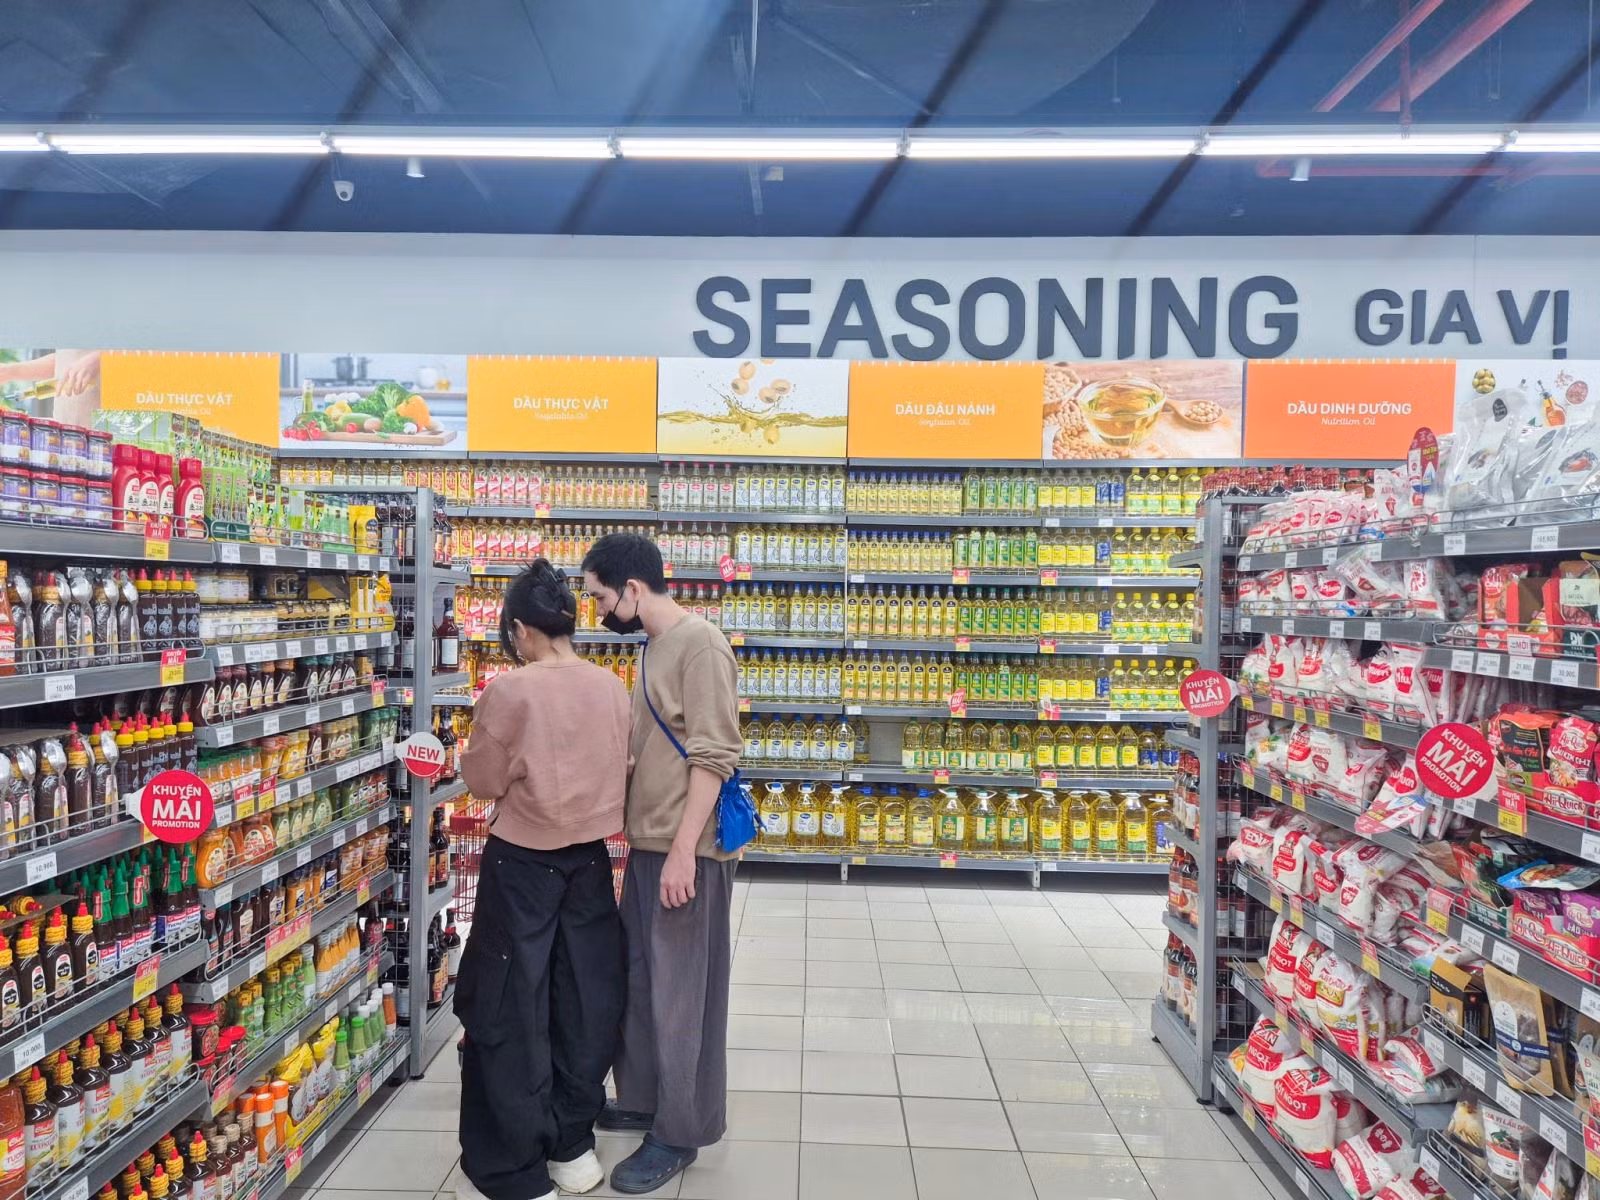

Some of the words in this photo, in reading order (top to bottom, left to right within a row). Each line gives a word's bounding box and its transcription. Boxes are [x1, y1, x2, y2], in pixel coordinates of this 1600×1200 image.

[693, 276, 1299, 361] SEASONING
[1355, 289, 1482, 346] GIA
[1496, 290, 1570, 359] VỊ
[513, 395, 541, 409] DẦU
[543, 397, 581, 412] THỰC
[583, 396, 609, 412] VẬT
[895, 401, 923, 415] DẦU
[1287, 400, 1317, 414] DẦU
[1320, 402, 1355, 415] DINH
[1358, 401, 1412, 415] DƯỠNG
[1321, 417, 1360, 426] Nutrition
[1362, 417, 1376, 426] Oil
[1188, 684, 1224, 705] MÃI
[407, 744, 440, 761] NEW
[1441, 728, 1487, 768] KHUYẾN
[1425, 740, 1478, 787] MÃI
[1420, 755, 1463, 793] PROMOTION
[152, 784, 202, 797] KHUYẾN
[152, 794, 202, 821] MÃI
[151, 820, 201, 830] PROMOTION
